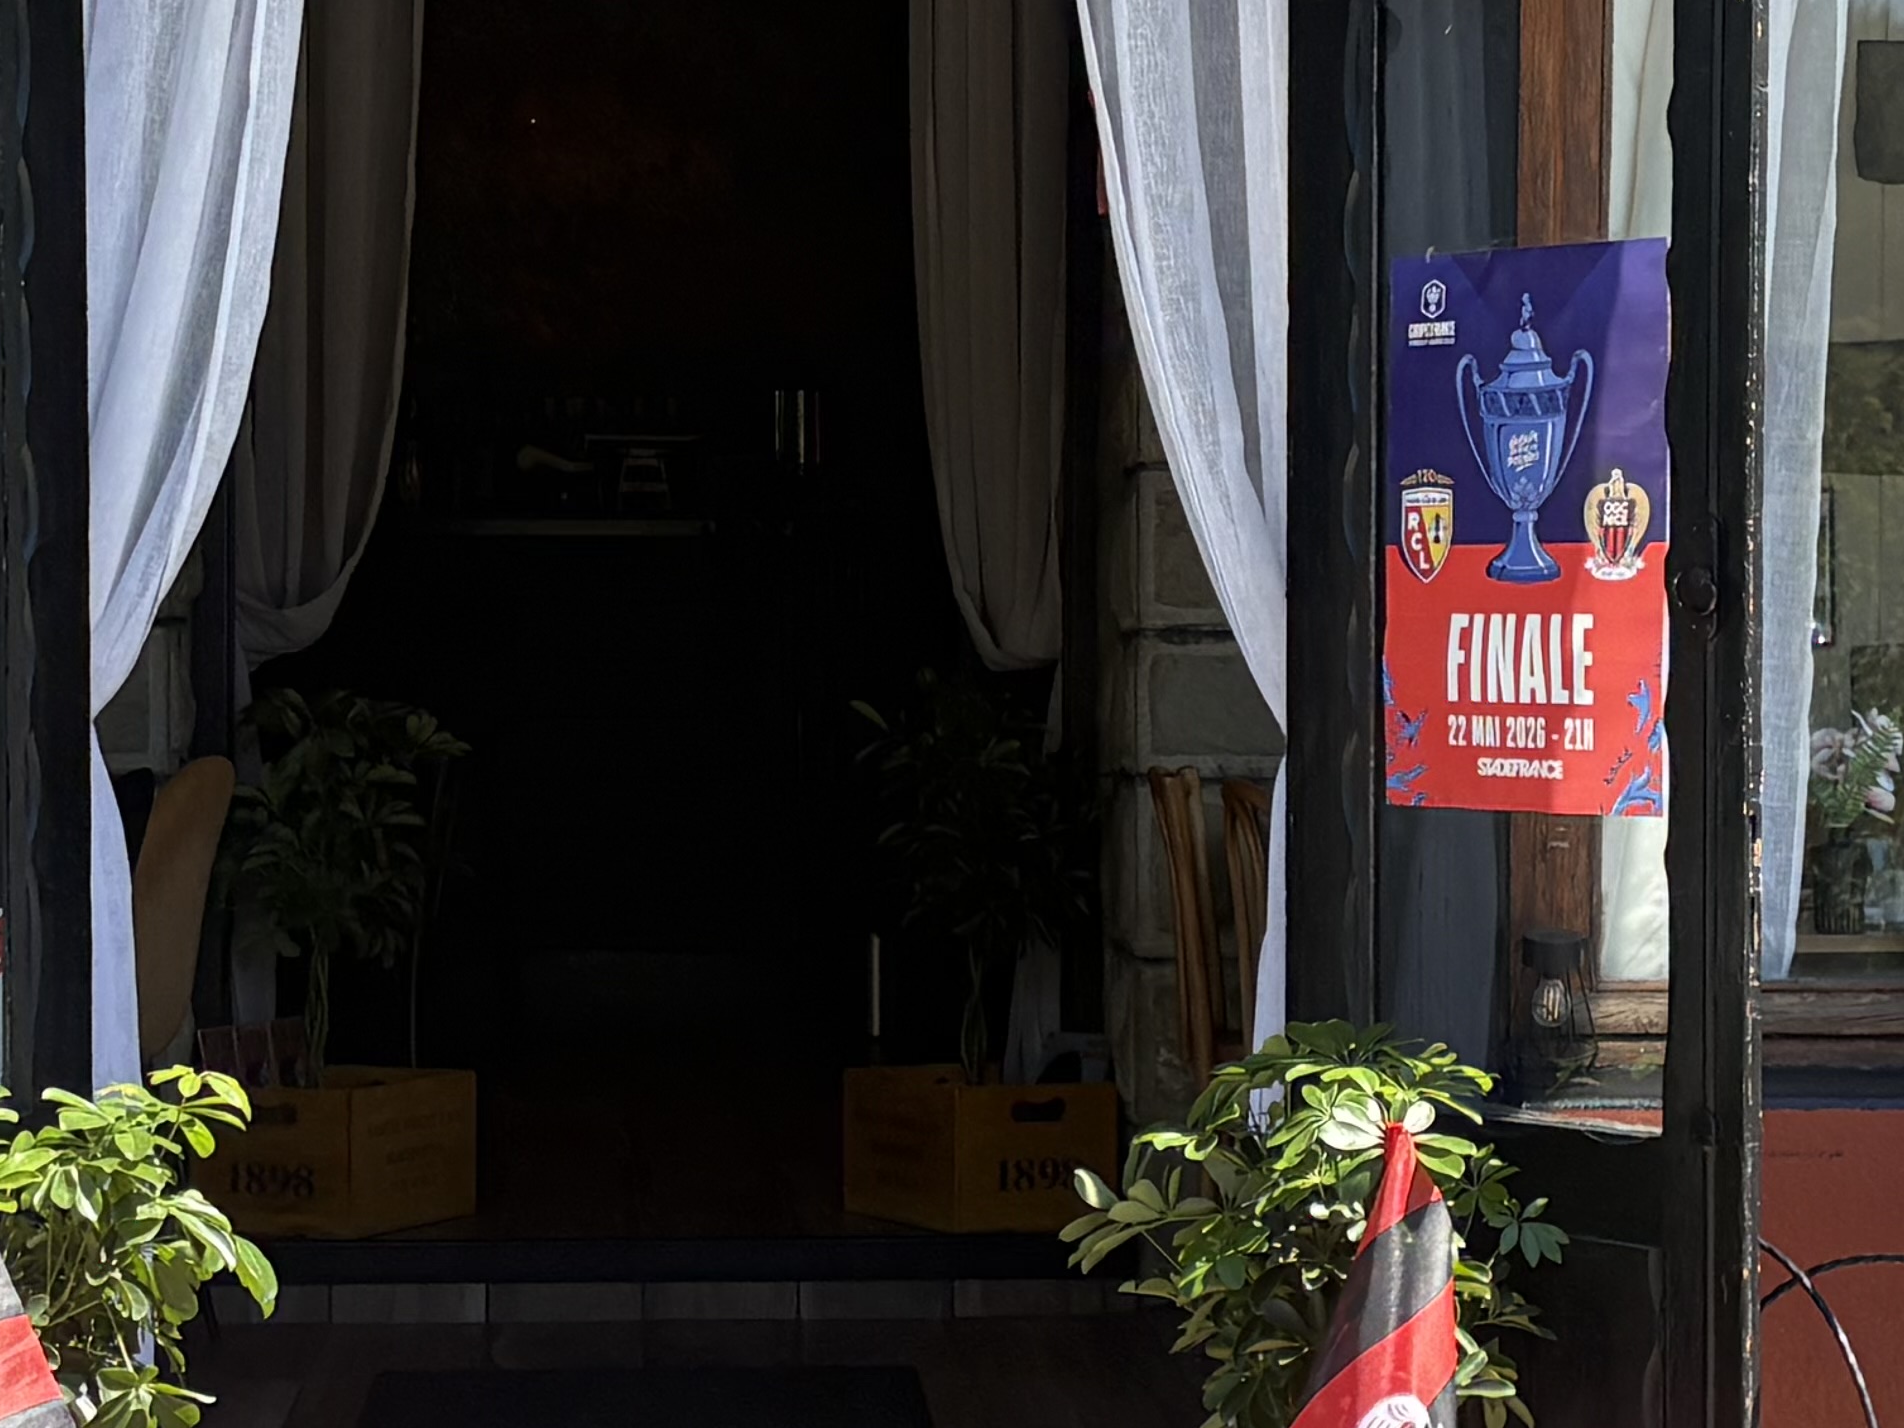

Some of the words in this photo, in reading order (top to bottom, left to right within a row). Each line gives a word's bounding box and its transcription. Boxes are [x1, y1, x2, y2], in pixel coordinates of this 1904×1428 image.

[1447, 613, 1594, 705] FINALE
[1448, 714, 1467, 747] 22
[1471, 715, 1500, 747] MAI
[1506, 716, 1546, 749] 2026
[1564, 717, 1595, 751] 21H
